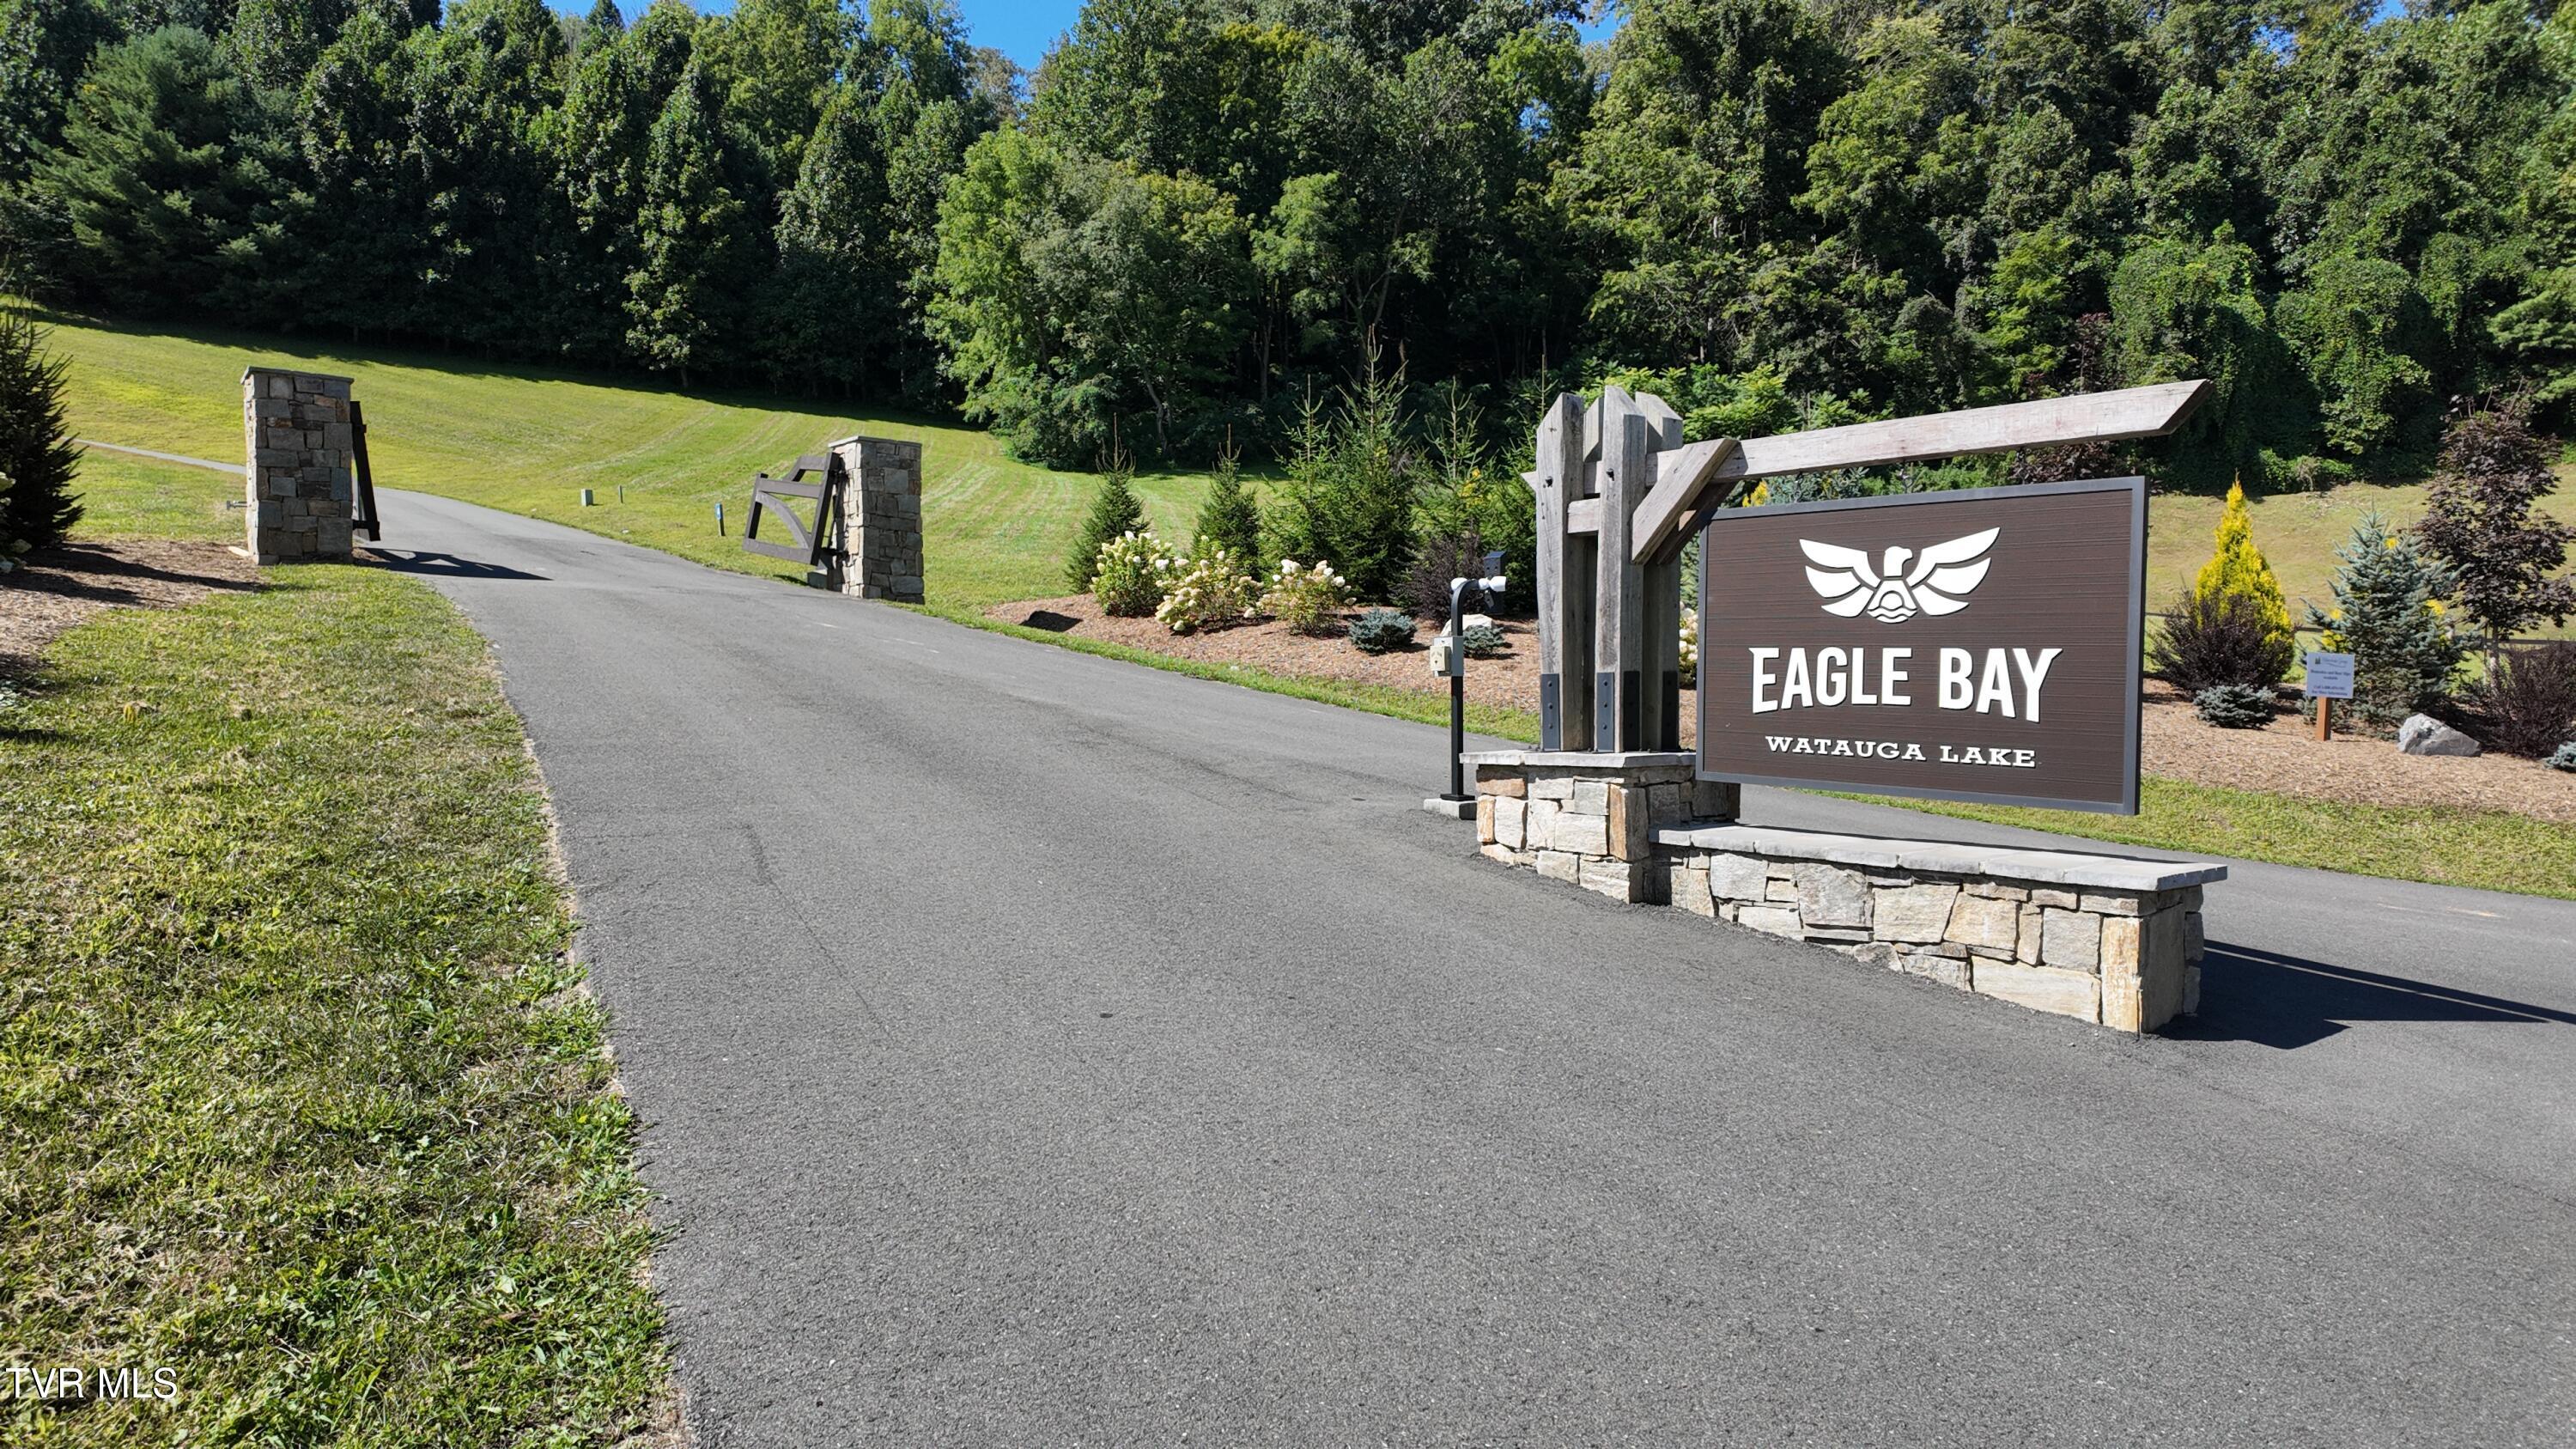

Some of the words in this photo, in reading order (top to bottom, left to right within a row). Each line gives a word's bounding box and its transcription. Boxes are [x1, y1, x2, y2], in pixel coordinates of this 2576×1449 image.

[1748, 647, 1913, 715] EAGLE
[1938, 648, 2063, 723] BAY
[1765, 735, 1926, 761] WATAUGA
[1940, 745, 2036, 768] LAKE
